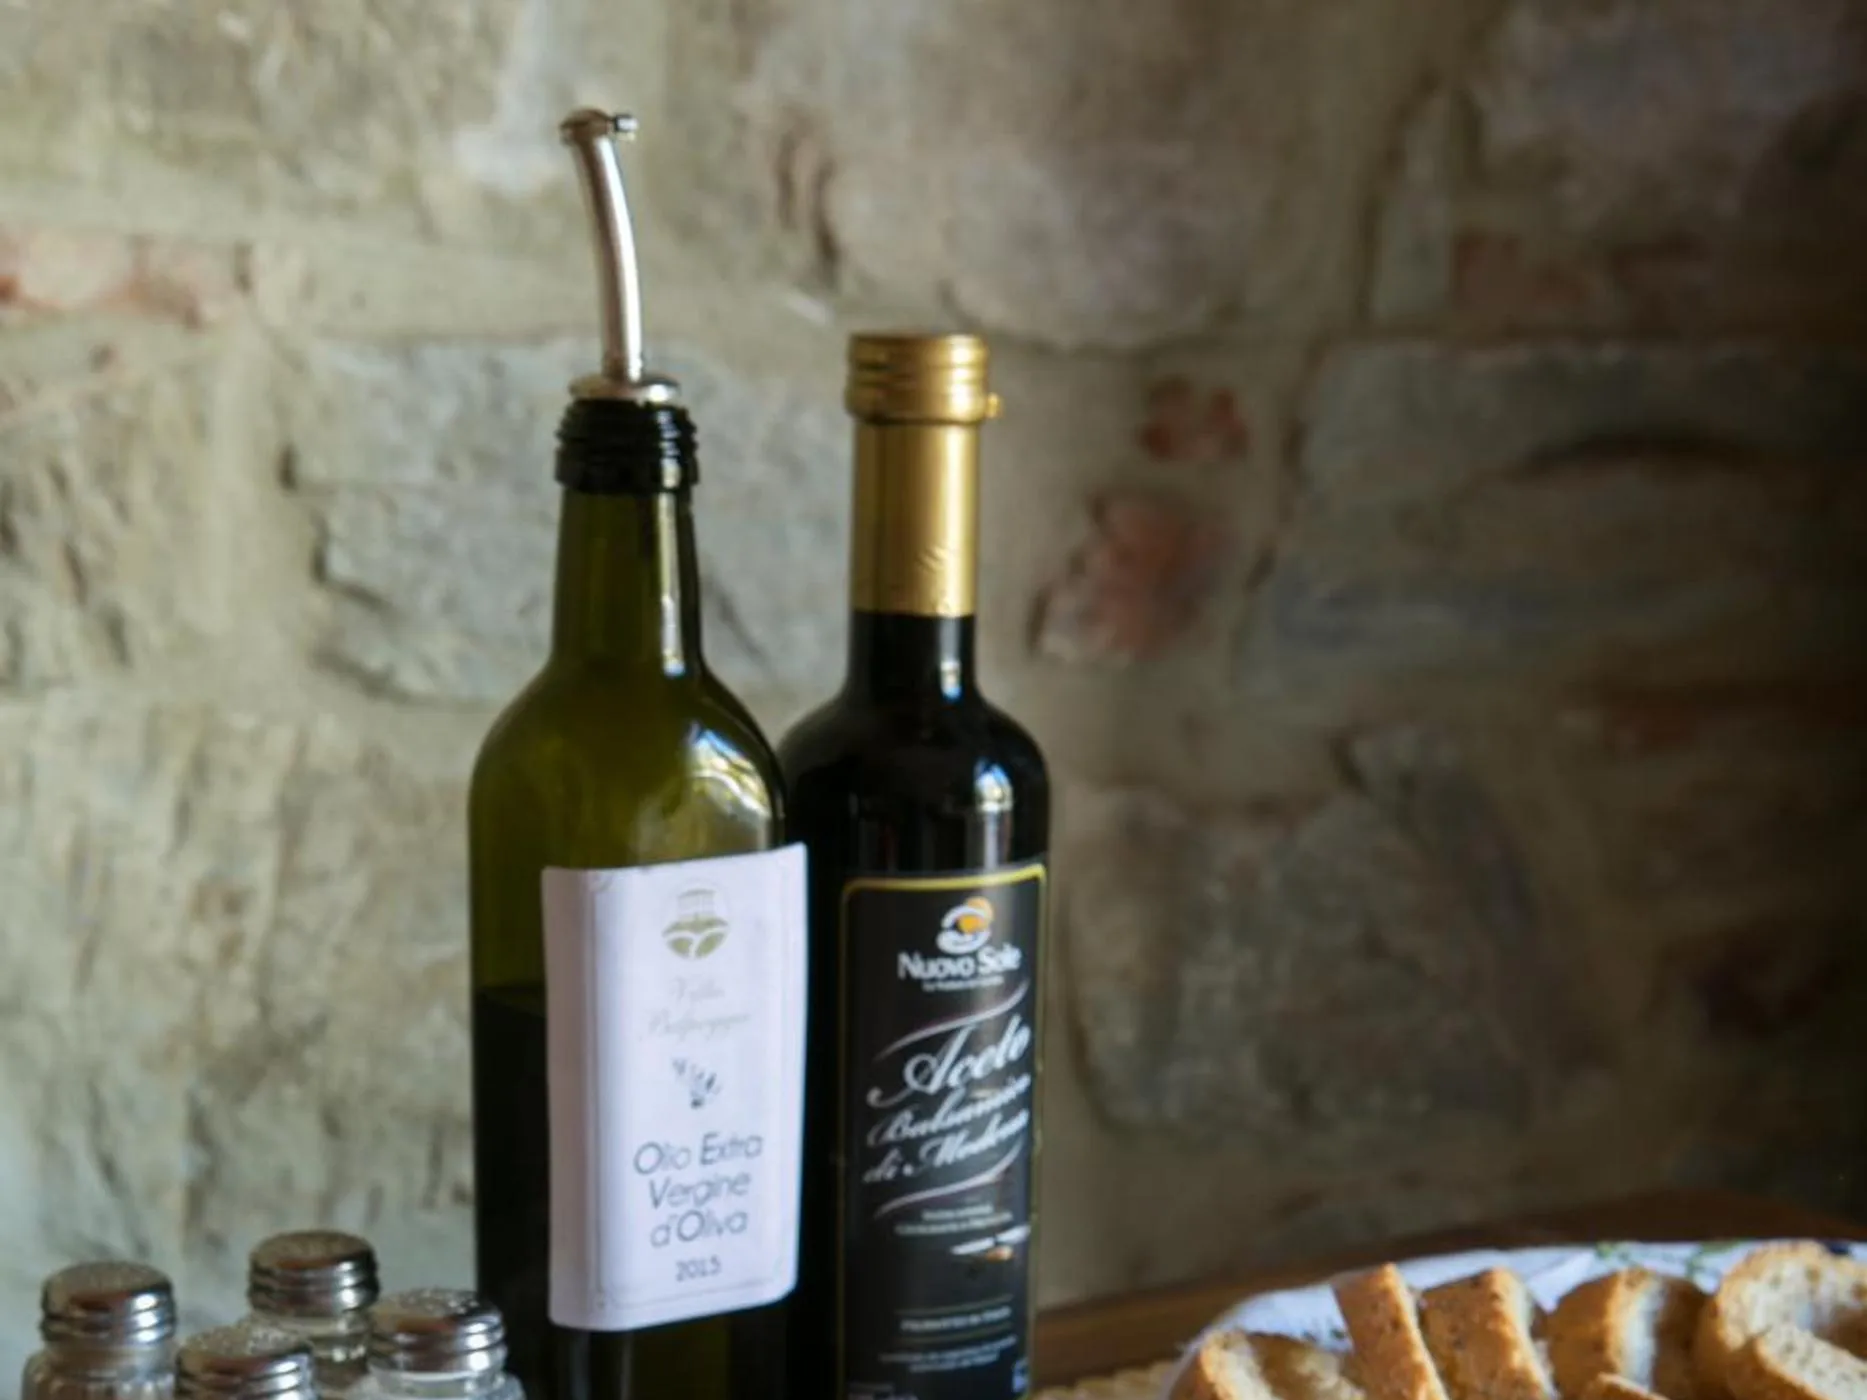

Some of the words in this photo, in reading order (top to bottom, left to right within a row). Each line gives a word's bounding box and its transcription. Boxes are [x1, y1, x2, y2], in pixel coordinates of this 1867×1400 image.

[897, 952, 976, 980] Nuovo
[633, 1141, 691, 1175] Olio
[700, 1132, 763, 1166] Extra
[649, 1172, 751, 1209] Vergine
